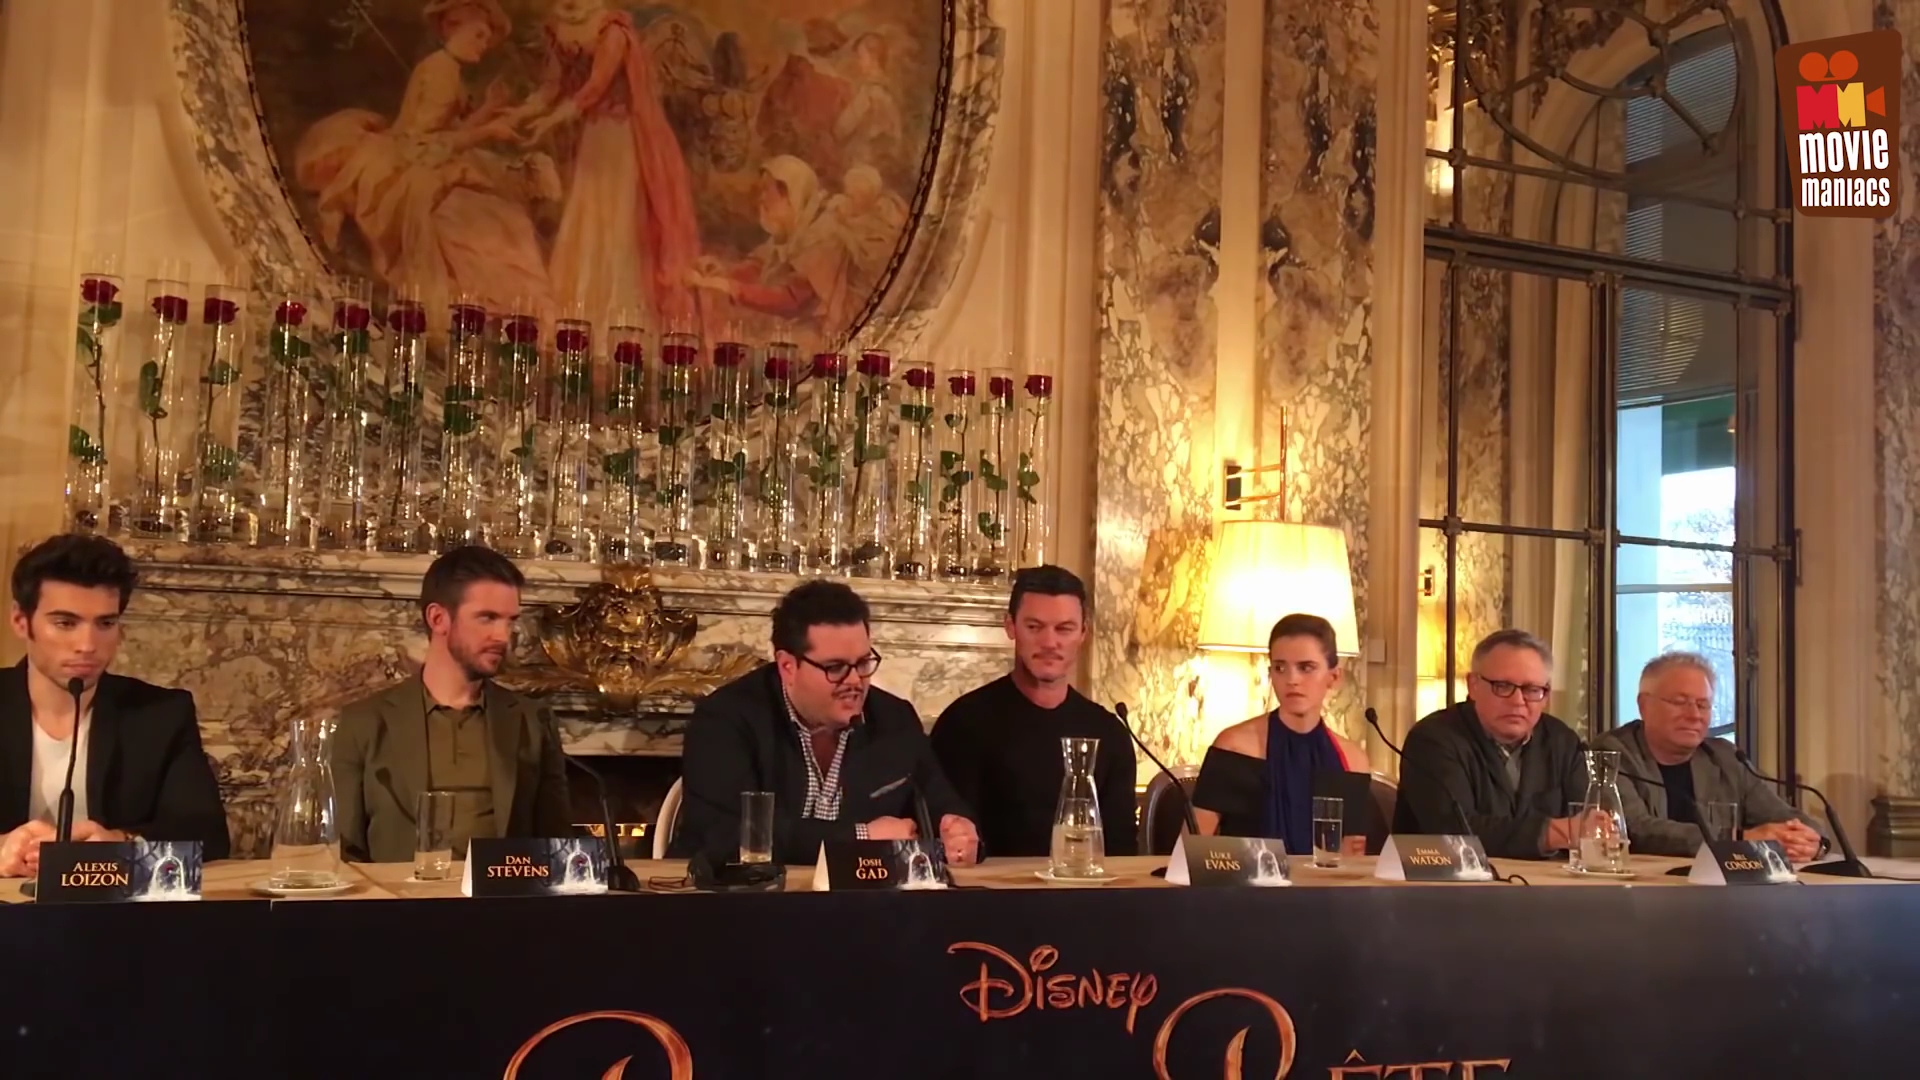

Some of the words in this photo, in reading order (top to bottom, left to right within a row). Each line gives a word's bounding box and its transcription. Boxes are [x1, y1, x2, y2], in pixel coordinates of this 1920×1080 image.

[505, 855, 531, 865] DAN
[1209, 849, 1232, 860] LUKE
[858, 857, 882, 868] JOSH
[1205, 859, 1241, 871] EVANS
[1408, 855, 1452, 866] WATSON
[72, 862, 119, 873] ALEXIS
[487, 865, 549, 877] STEVENS
[855, 867, 888, 880] GAD
[61, 872, 129, 887] LOIZON
